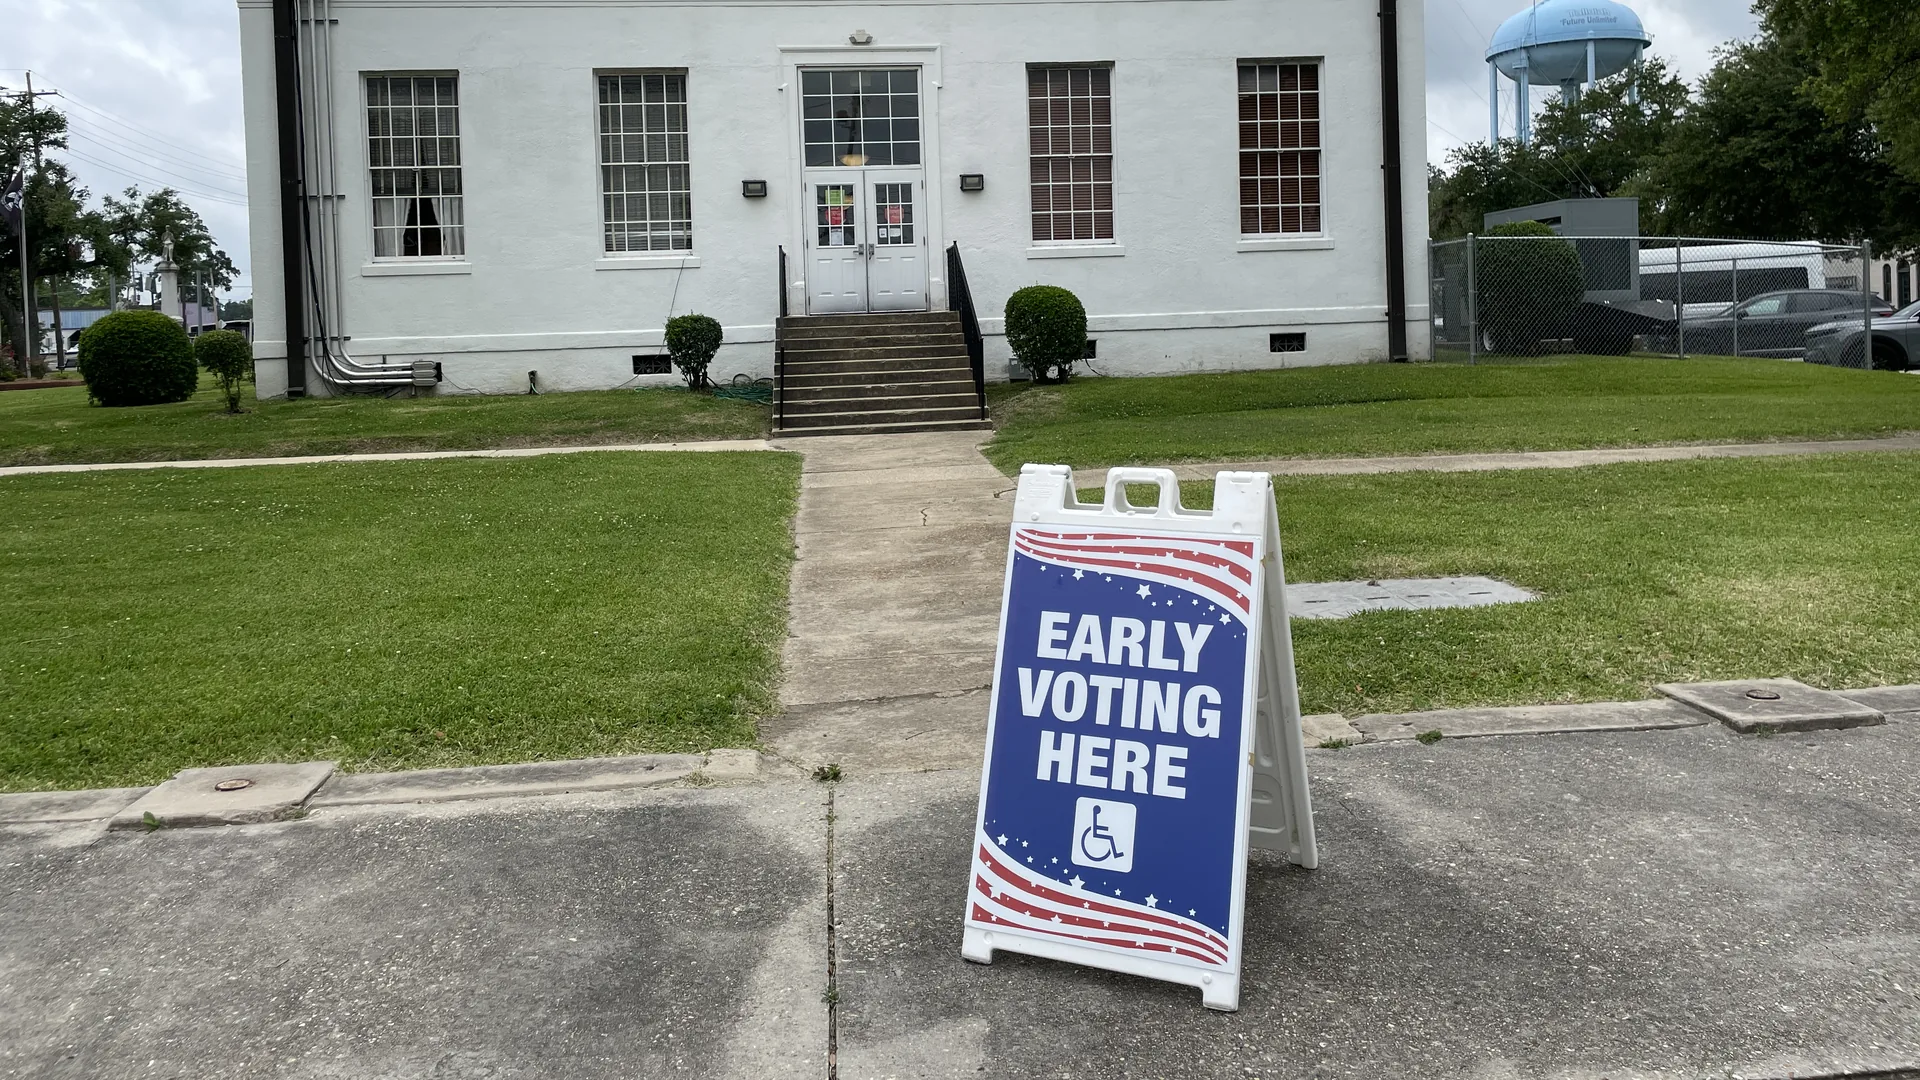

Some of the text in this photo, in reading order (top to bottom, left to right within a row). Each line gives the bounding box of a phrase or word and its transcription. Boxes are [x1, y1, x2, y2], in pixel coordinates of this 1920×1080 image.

[1037, 611, 1214, 673] EARLY
[1018, 667, 1222, 739] VOTING
[1036, 730, 1188, 799] HERE
